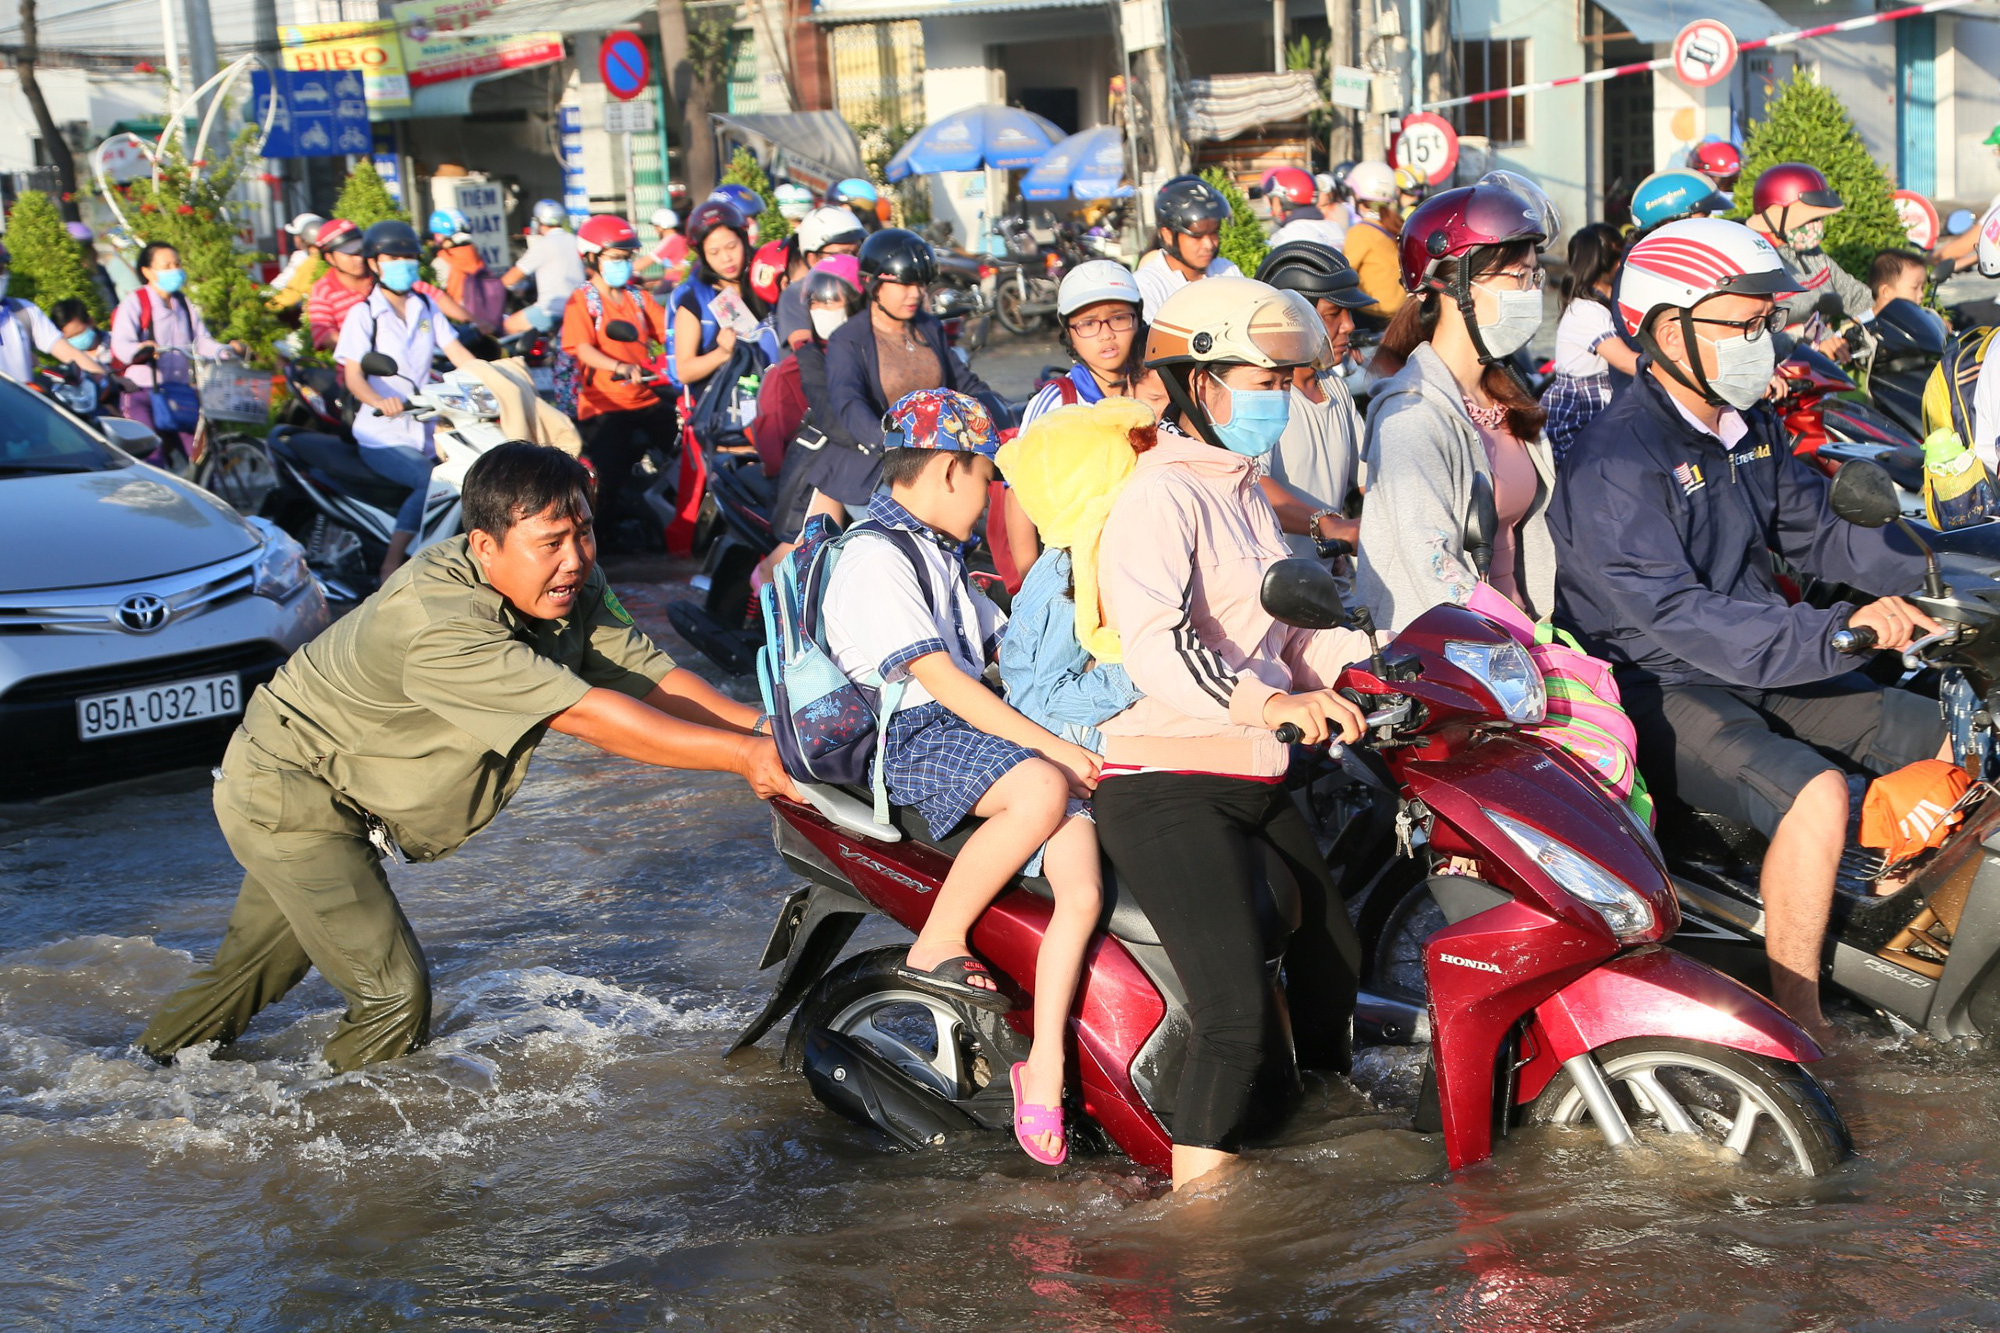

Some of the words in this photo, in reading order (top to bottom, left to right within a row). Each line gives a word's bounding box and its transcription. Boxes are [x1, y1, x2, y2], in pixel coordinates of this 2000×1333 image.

[295, 47, 388, 71] BIBO
[461, 187, 496, 209] TIỆM
[838, 842, 932, 893] VISION
[1440, 953, 1502, 974] HONDA
